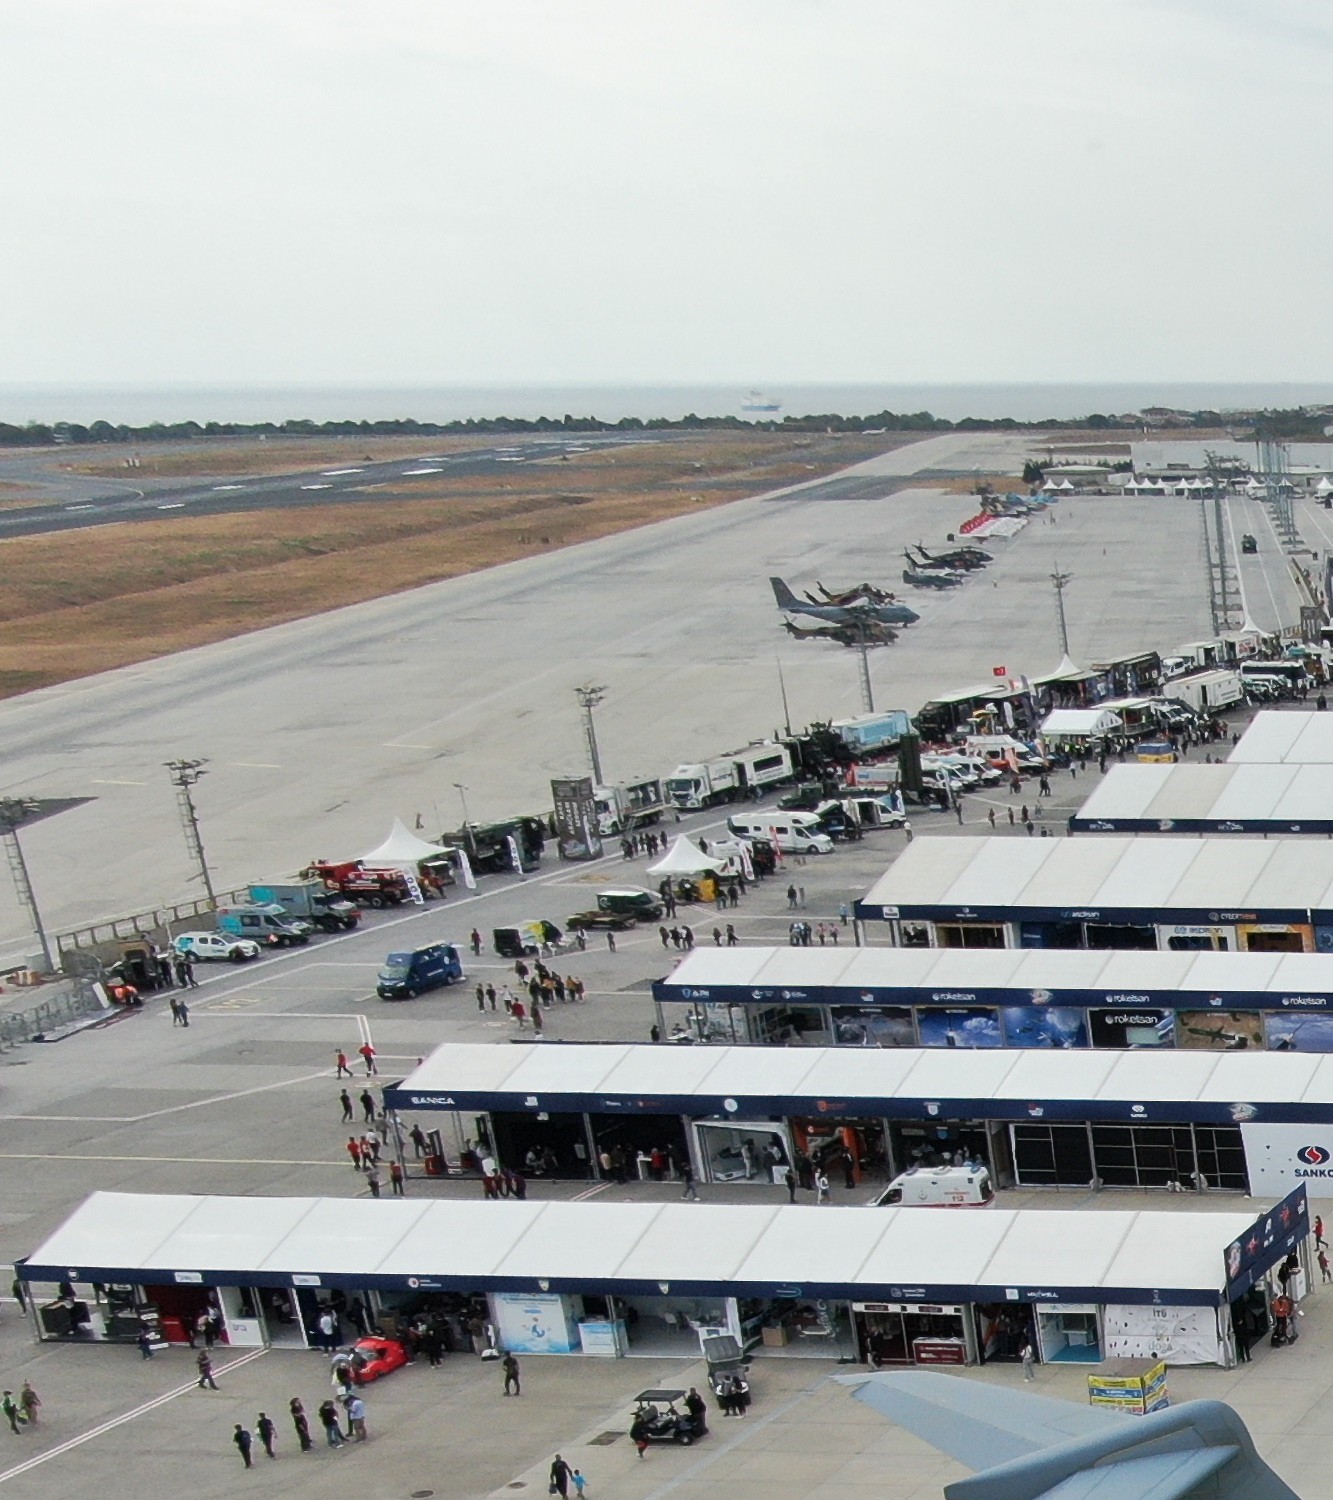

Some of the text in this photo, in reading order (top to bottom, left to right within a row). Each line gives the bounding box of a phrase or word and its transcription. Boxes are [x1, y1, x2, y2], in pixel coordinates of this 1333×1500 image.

[940, 992, 976, 1002] roketsan
[1114, 994, 1150, 1004] roketsan
[1290, 996, 1327, 1006] roketsan
[1114, 1014, 1158, 1025] roketsan
